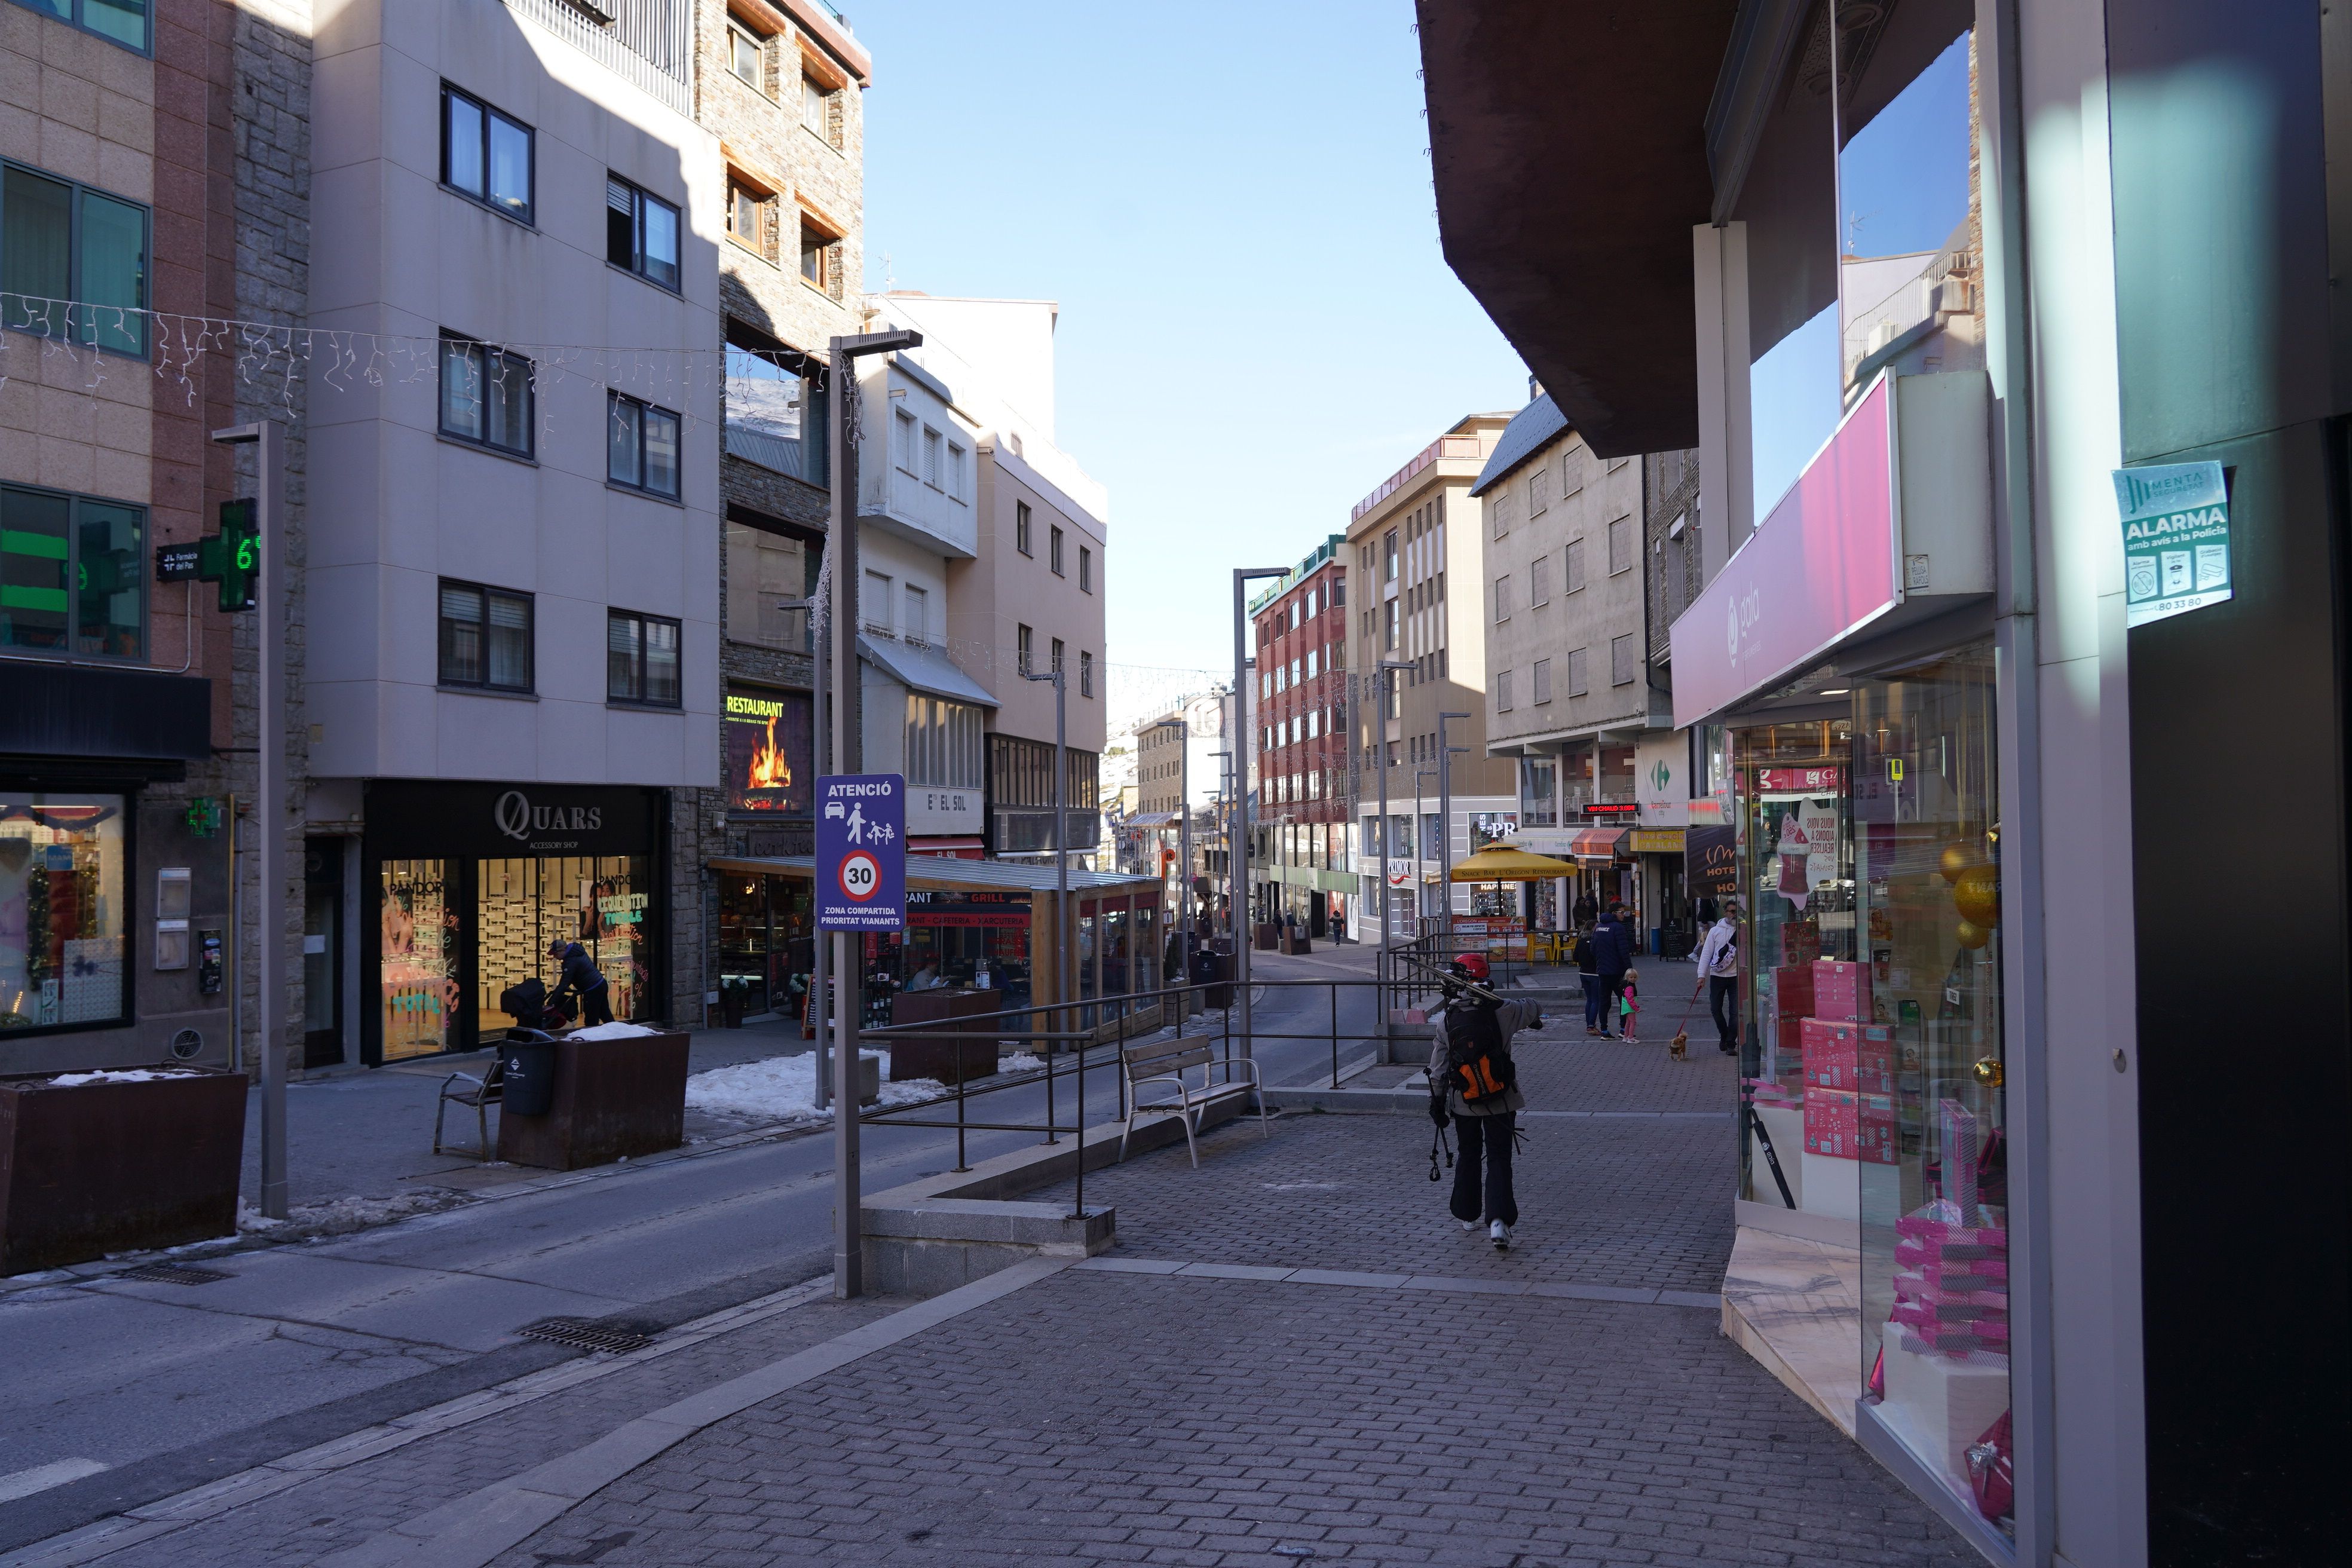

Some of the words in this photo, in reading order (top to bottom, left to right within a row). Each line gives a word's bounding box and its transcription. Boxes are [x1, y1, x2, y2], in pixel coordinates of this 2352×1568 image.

[2152, 473, 2202, 489] MENTA
[2154, 482, 2204, 497] SEGURETAT
[2126, 507, 2226, 540] ALARMA
[2128, 540, 2150, 551] amb
[2151, 536, 2171, 547] avís
[2181, 532, 2191, 541] la
[1741, 580, 1760, 639] gala
[2158, 602, 2172, 611] 80
[2174, 600, 2185, 608] 33
[2188, 598, 2201, 607] 80
[727, 696, 783, 718] RESTAURANT
[828, 781, 891, 797] ATENCIÓ
[941, 795, 949, 811] EL
[953, 795, 966, 811] SOL
[495, 791, 602, 840] QUARS
[1388, 860, 1410, 874] PRIMOR
[848, 868, 872, 884] 30
[972, 893, 1005, 902] GRILL
[978, 917, 1024, 925] XARCUTERIA
